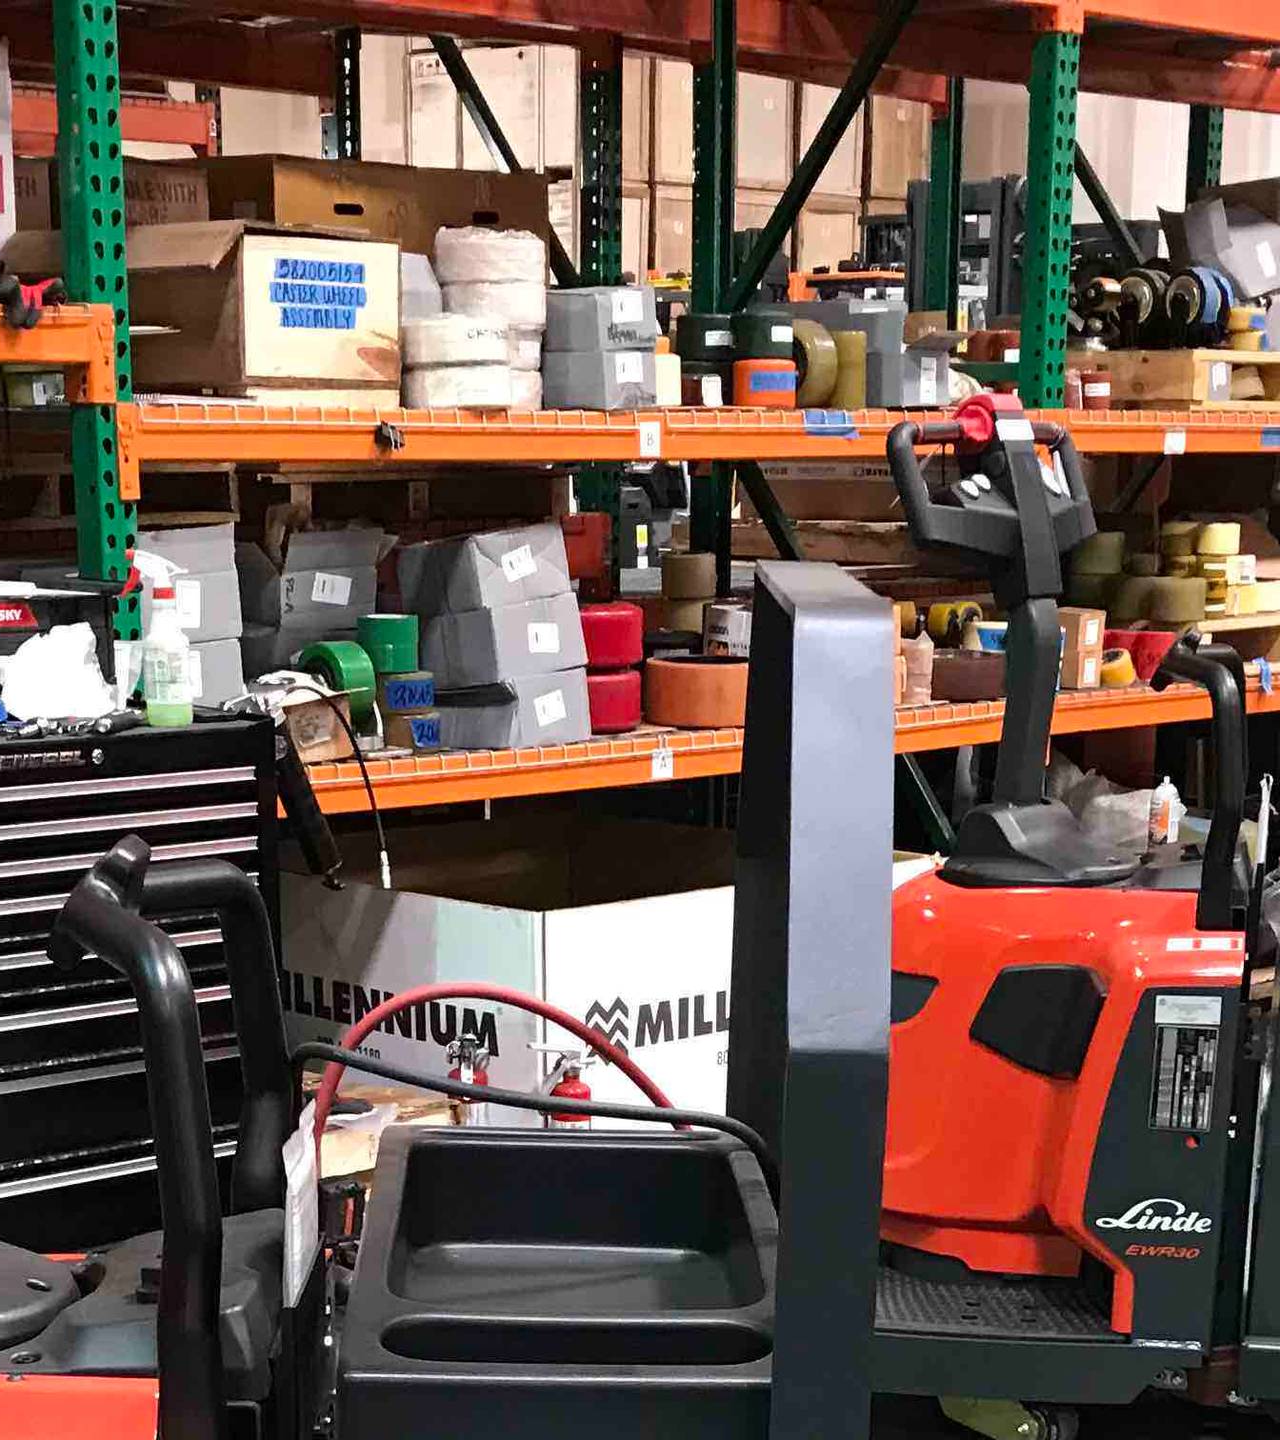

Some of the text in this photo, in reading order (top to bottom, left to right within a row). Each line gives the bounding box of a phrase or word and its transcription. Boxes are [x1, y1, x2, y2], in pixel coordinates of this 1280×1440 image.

[272, 282, 365, 307] CASTER WHEEL
[280, 306, 352, 329] ASSEMBLY
[279, 966, 501, 1057] ILLENNIUM
[634, 989, 730, 1048] MILL
[1095, 1198, 1212, 1234] Linde
[1125, 1243, 1201, 1260] EWR30
